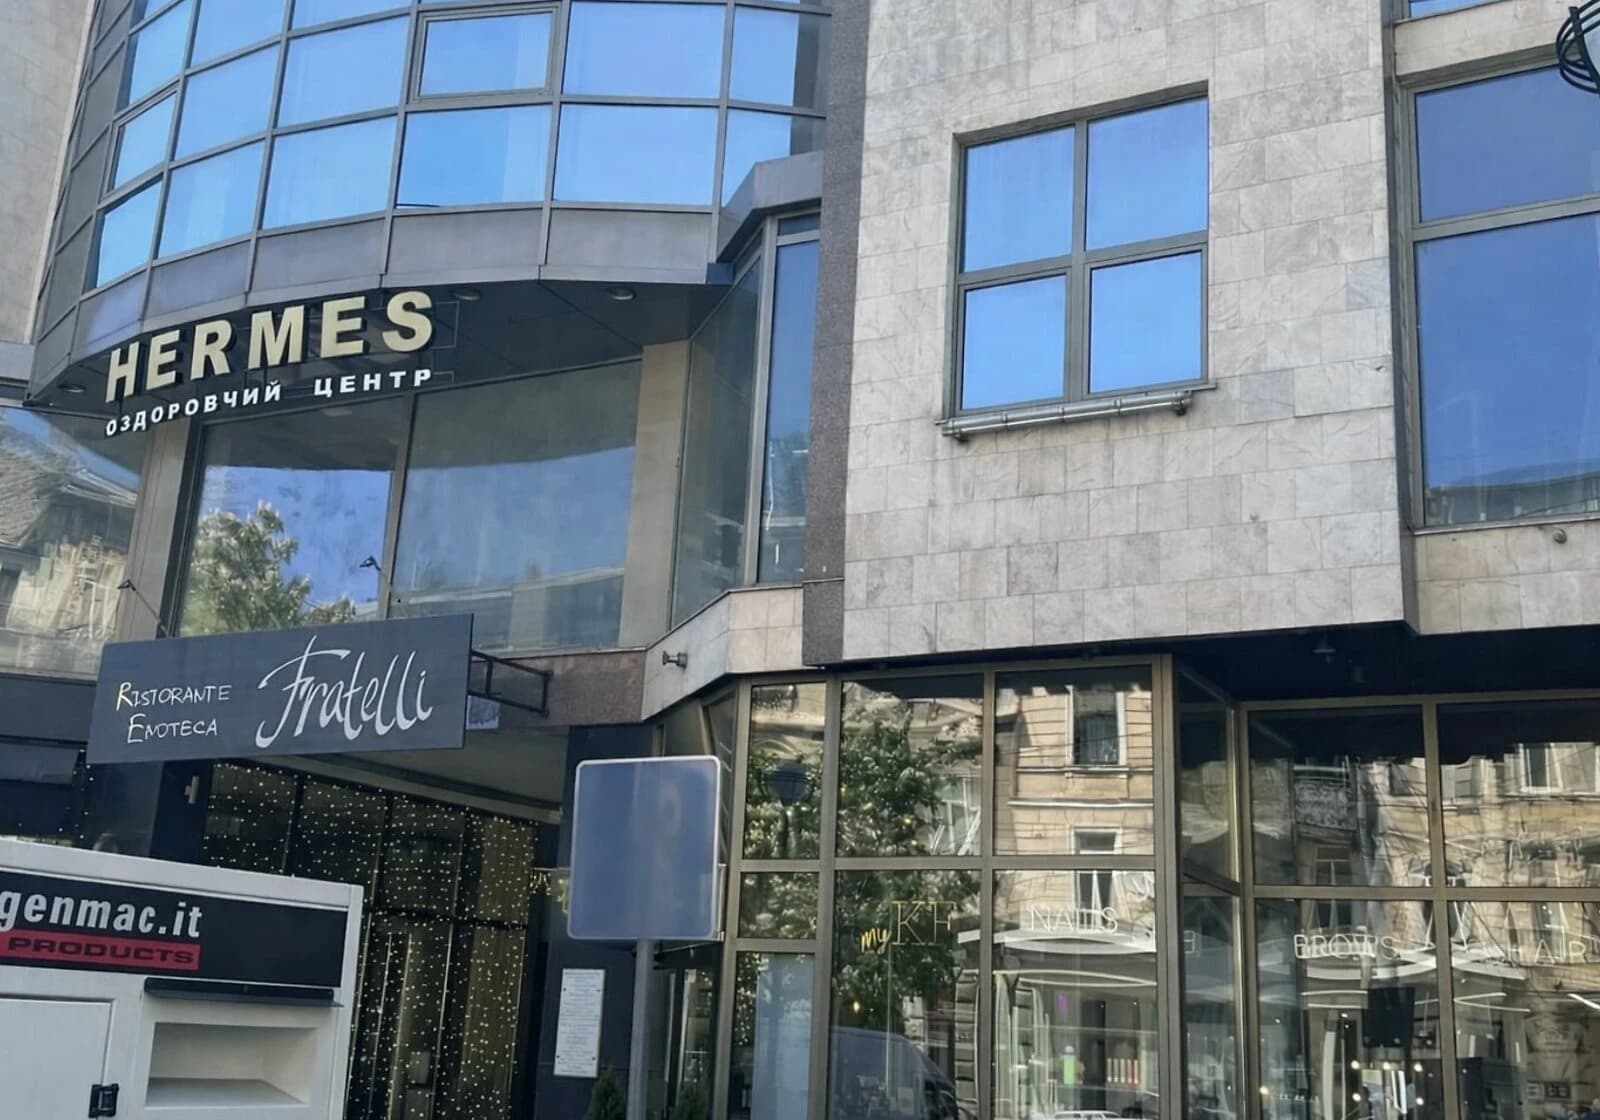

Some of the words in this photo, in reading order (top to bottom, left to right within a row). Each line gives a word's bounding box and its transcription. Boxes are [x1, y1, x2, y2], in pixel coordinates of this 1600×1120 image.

[105, 290, 433, 402] HERMES
[105, 380, 281, 436] ОЗДОРОВЧИЙ
[314, 368, 432, 397] ЦЕНТР
[255, 635, 433, 749] Fratelli
[0, 890, 202, 937] genmac.it
[1031, 906, 1118, 933] NAILS
[8, 937, 195, 964] PRODUCTS
[1294, 933, 1401, 959] BROWS
